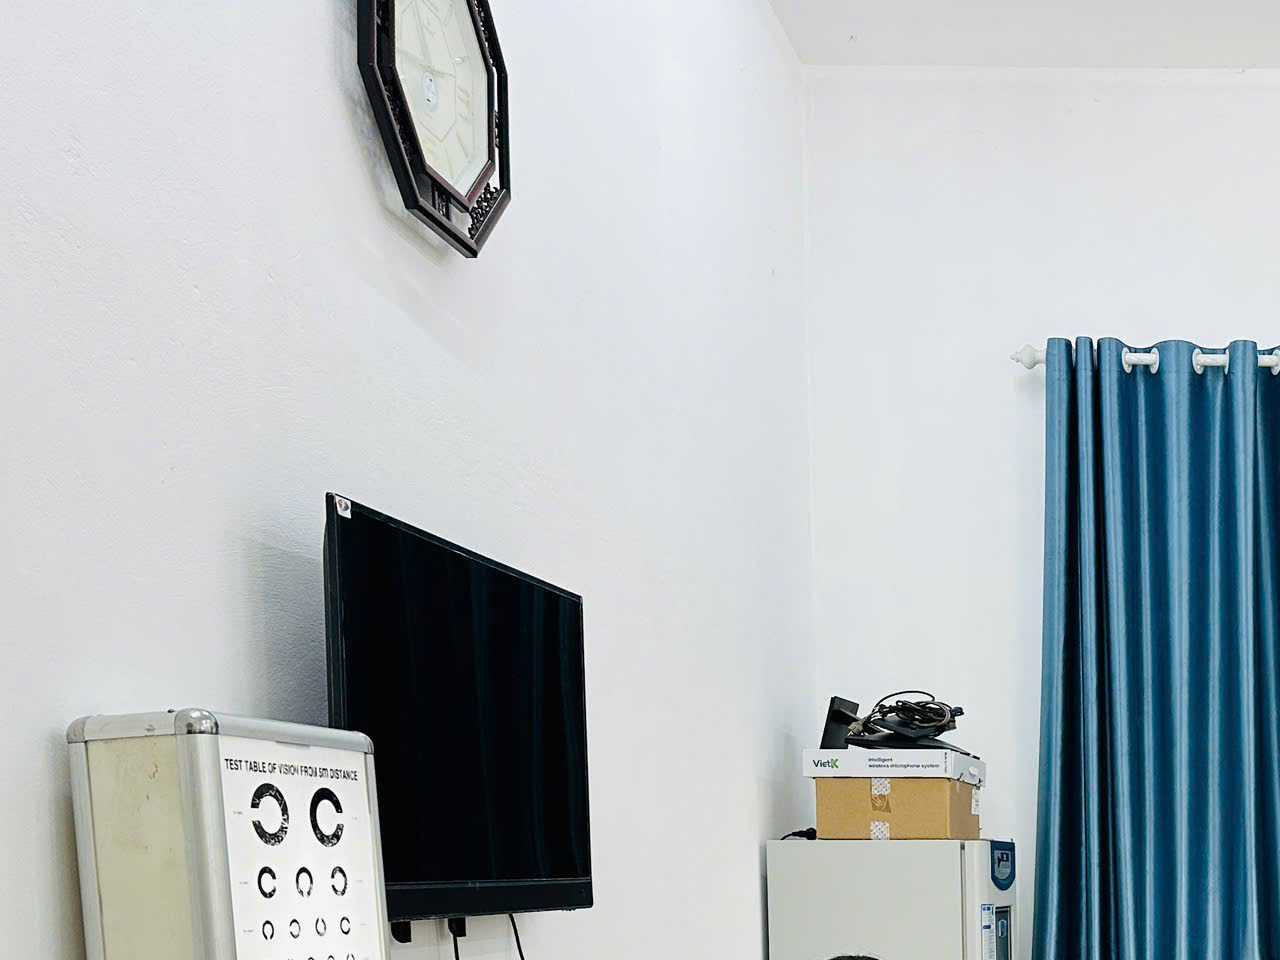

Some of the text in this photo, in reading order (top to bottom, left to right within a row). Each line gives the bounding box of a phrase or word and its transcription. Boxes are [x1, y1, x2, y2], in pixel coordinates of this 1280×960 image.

[224, 758, 243, 771] TEST
[245, 760, 267, 774] TABLE
[268, 762, 277, 774] OF
[278, 763, 299, 777] VISION
[300, 765, 318, 778] FROM
[330, 768, 358, 781] DISTANCE
